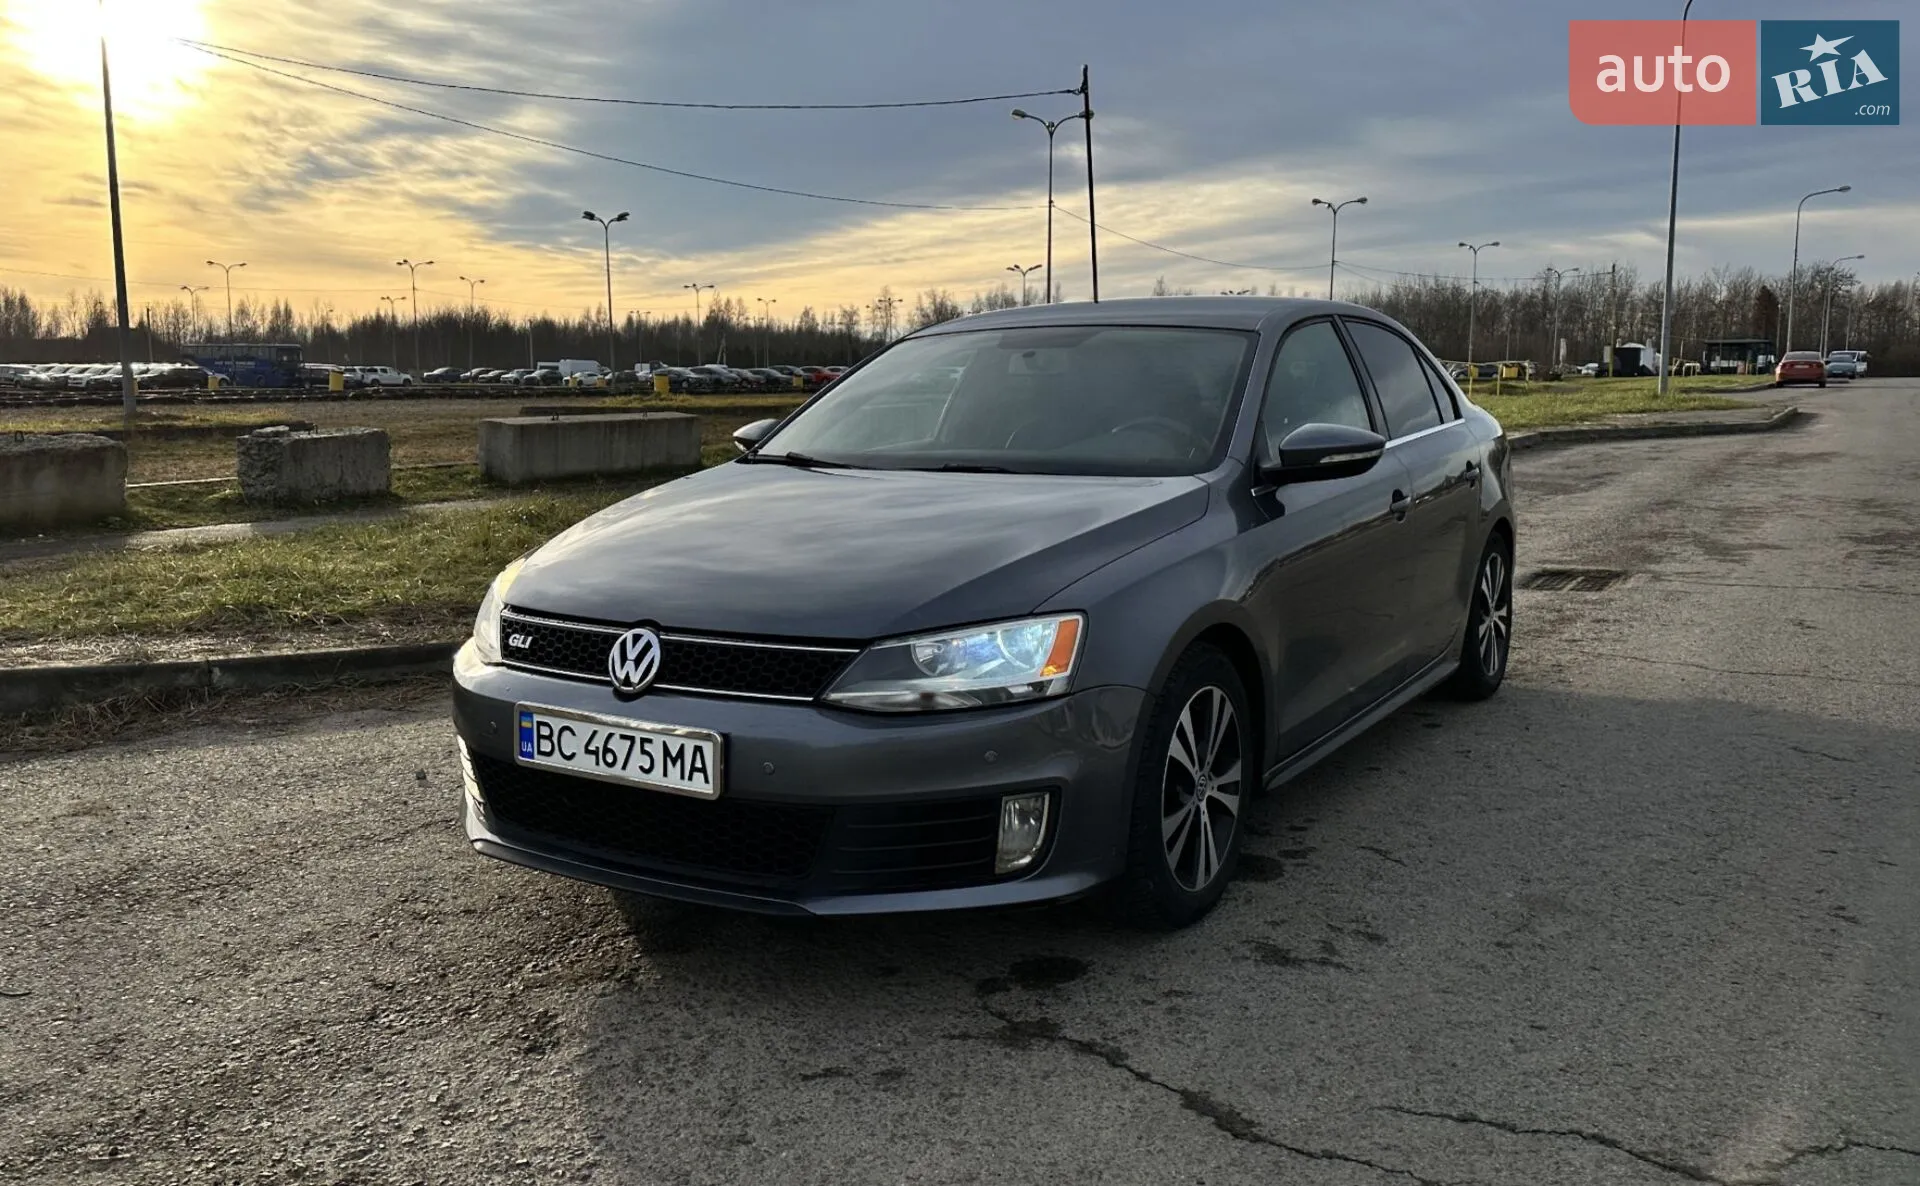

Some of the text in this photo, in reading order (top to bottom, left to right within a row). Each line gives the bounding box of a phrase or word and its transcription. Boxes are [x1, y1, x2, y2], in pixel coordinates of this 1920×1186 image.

[508, 633, 533, 649] GLI
[521, 741, 533, 753] UA
[536, 720, 710, 785] BC 4675 MA
